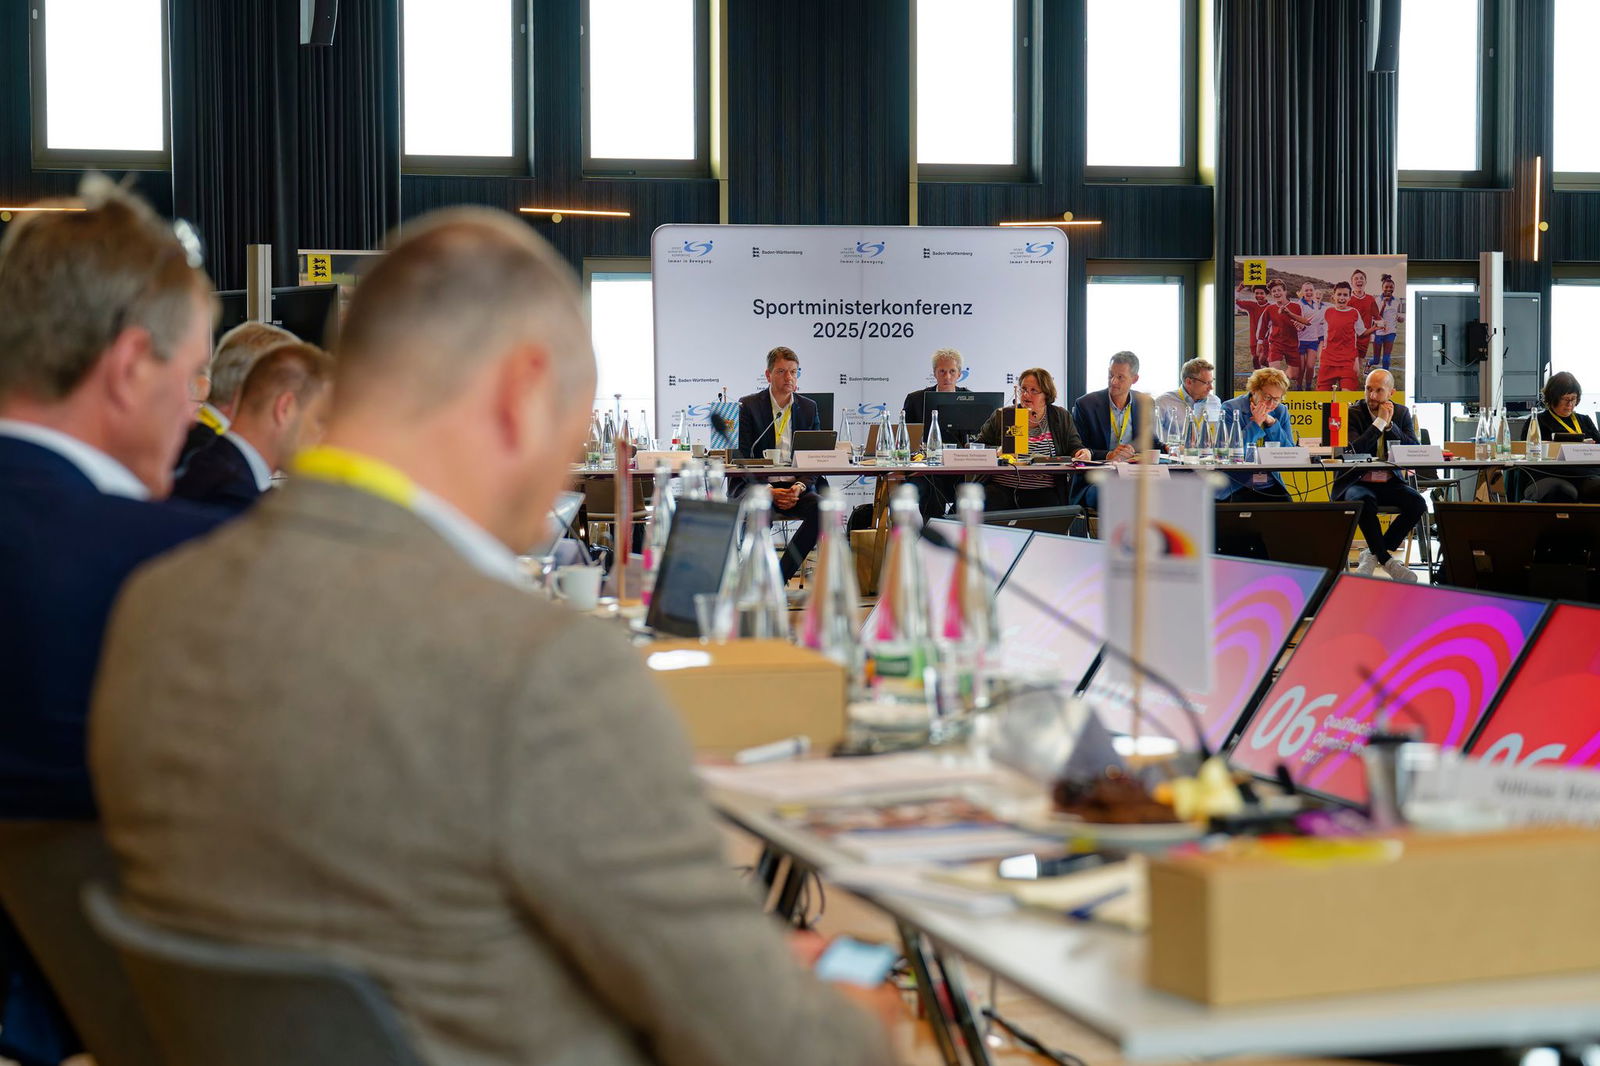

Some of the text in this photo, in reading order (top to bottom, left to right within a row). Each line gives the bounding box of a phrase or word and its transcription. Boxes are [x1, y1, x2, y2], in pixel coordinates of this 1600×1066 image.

[752, 298, 973, 319] Sportministerkonferenz
[812, 321, 915, 340] 2025/2026
[1250, 684, 1339, 758] 06
